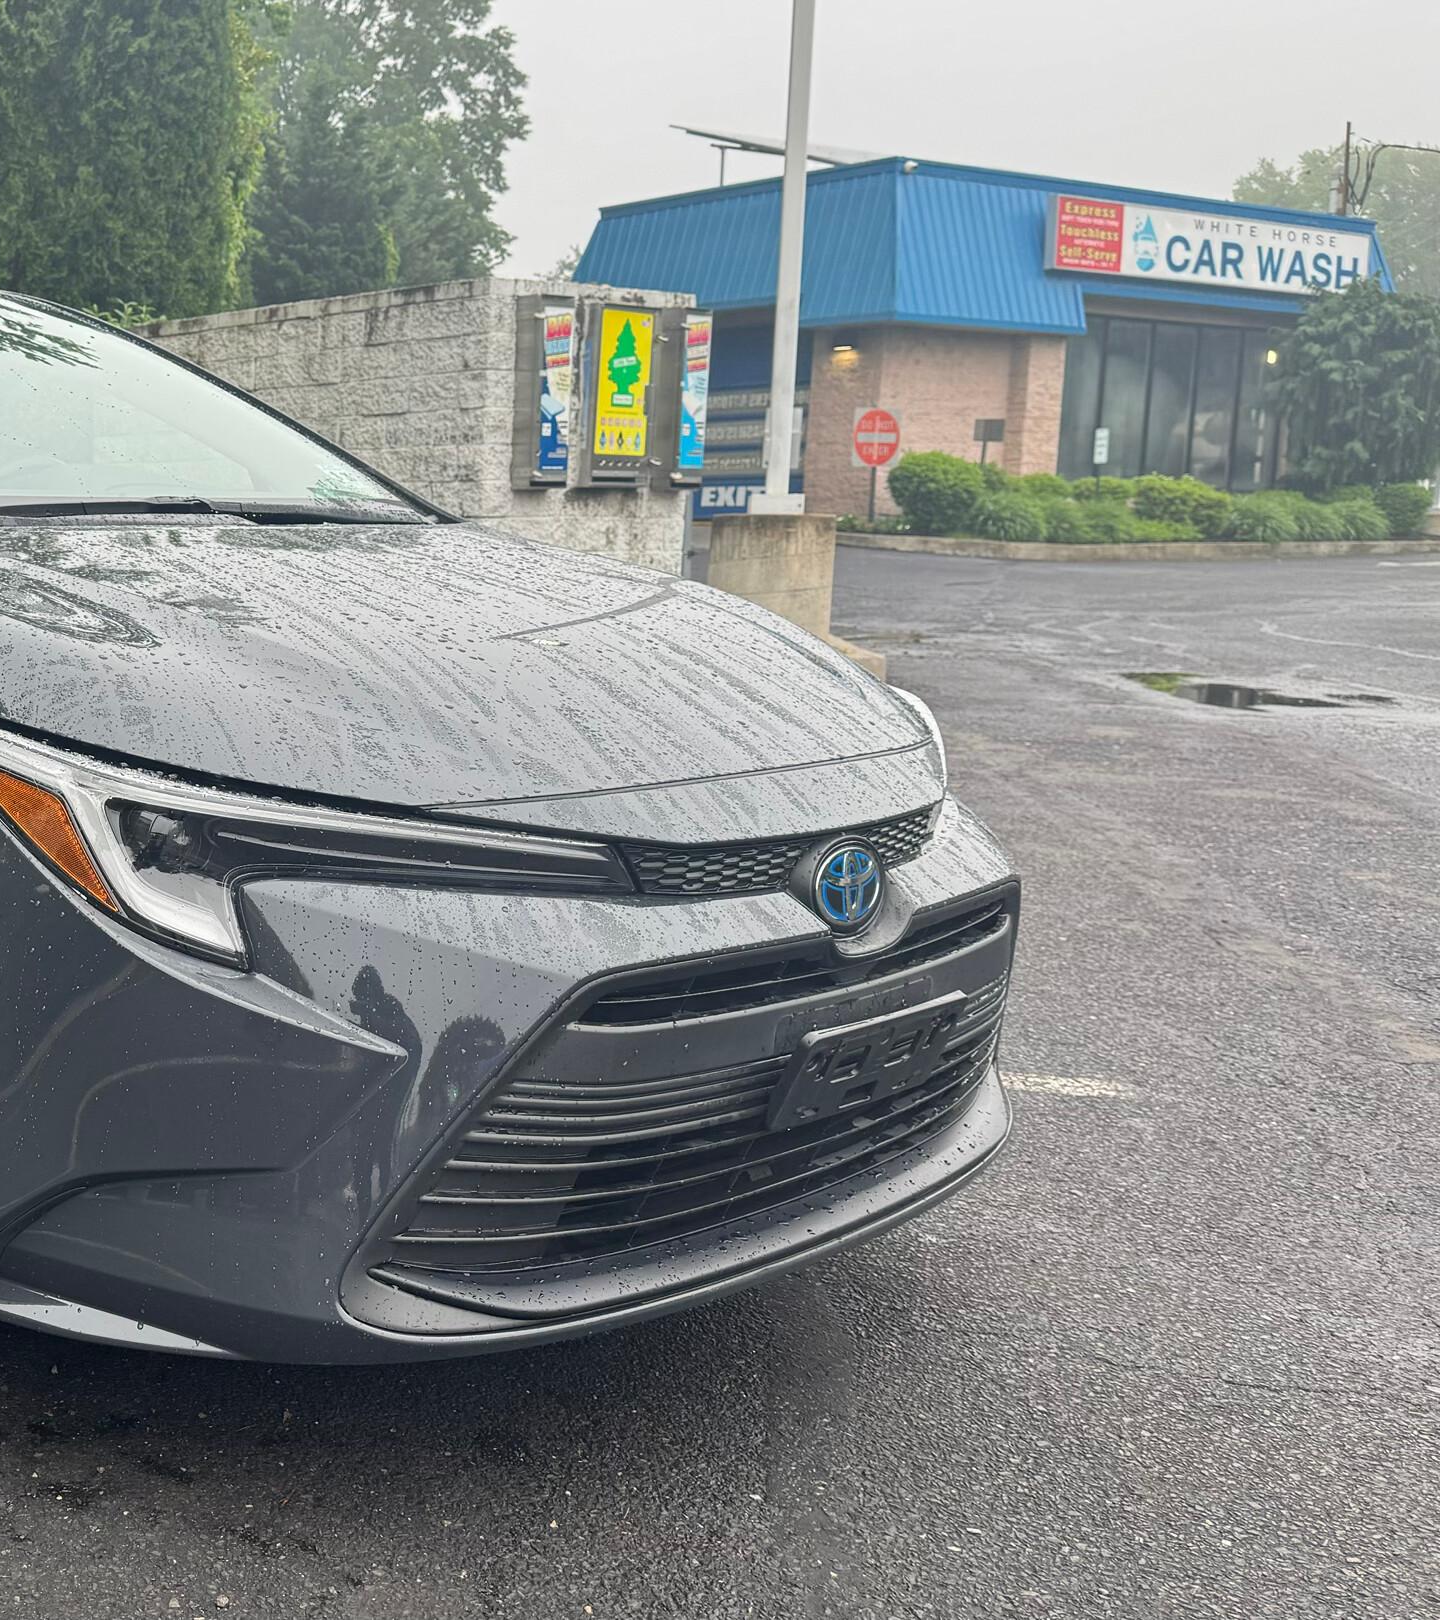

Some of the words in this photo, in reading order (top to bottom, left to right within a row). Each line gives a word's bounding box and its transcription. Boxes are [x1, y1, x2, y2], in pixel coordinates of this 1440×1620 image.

[1064, 201, 1116, 218] Express
[1060, 223, 1119, 241] Touchless
[1193, 219, 1259, 238] WHITE
[1272, 229, 1337, 249] HORSE
[1165, 235, 1244, 280] CAR
[1256, 245, 1360, 290] WASH
[862, 445, 888, 457] ENER
